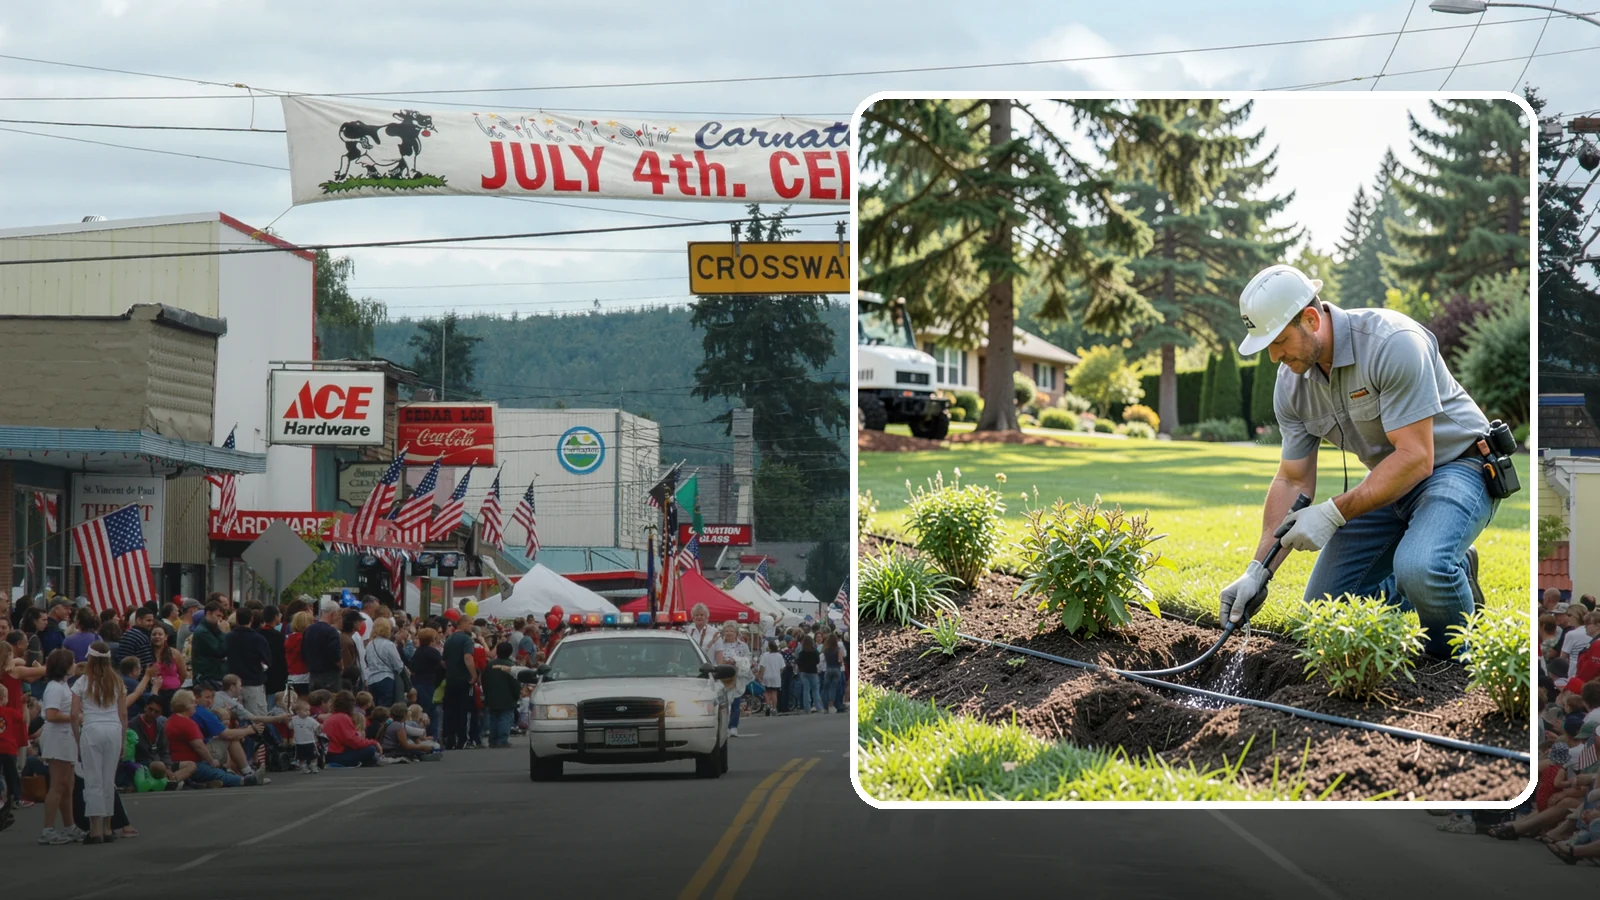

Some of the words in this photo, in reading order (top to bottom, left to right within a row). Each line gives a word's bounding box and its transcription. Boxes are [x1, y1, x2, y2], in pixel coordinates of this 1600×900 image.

[695, 121, 850, 150] Carnat
[481, 140, 605, 193] JULY
[632, 149, 746, 198] 4th.
[283, 380, 373, 420] ACE
[405, 409, 452, 422] CEDAR
[461, 410, 485, 422] LOG
[283, 421, 371, 437] Hardware
[416, 428, 477, 447] Coca-Cola
[95, 485, 124, 495] Vincent
[126, 485, 136, 495] de
[137, 485, 155, 495] Paul
[212, 516, 331, 536] HARDARE
[699, 535, 730, 543] GLASS
